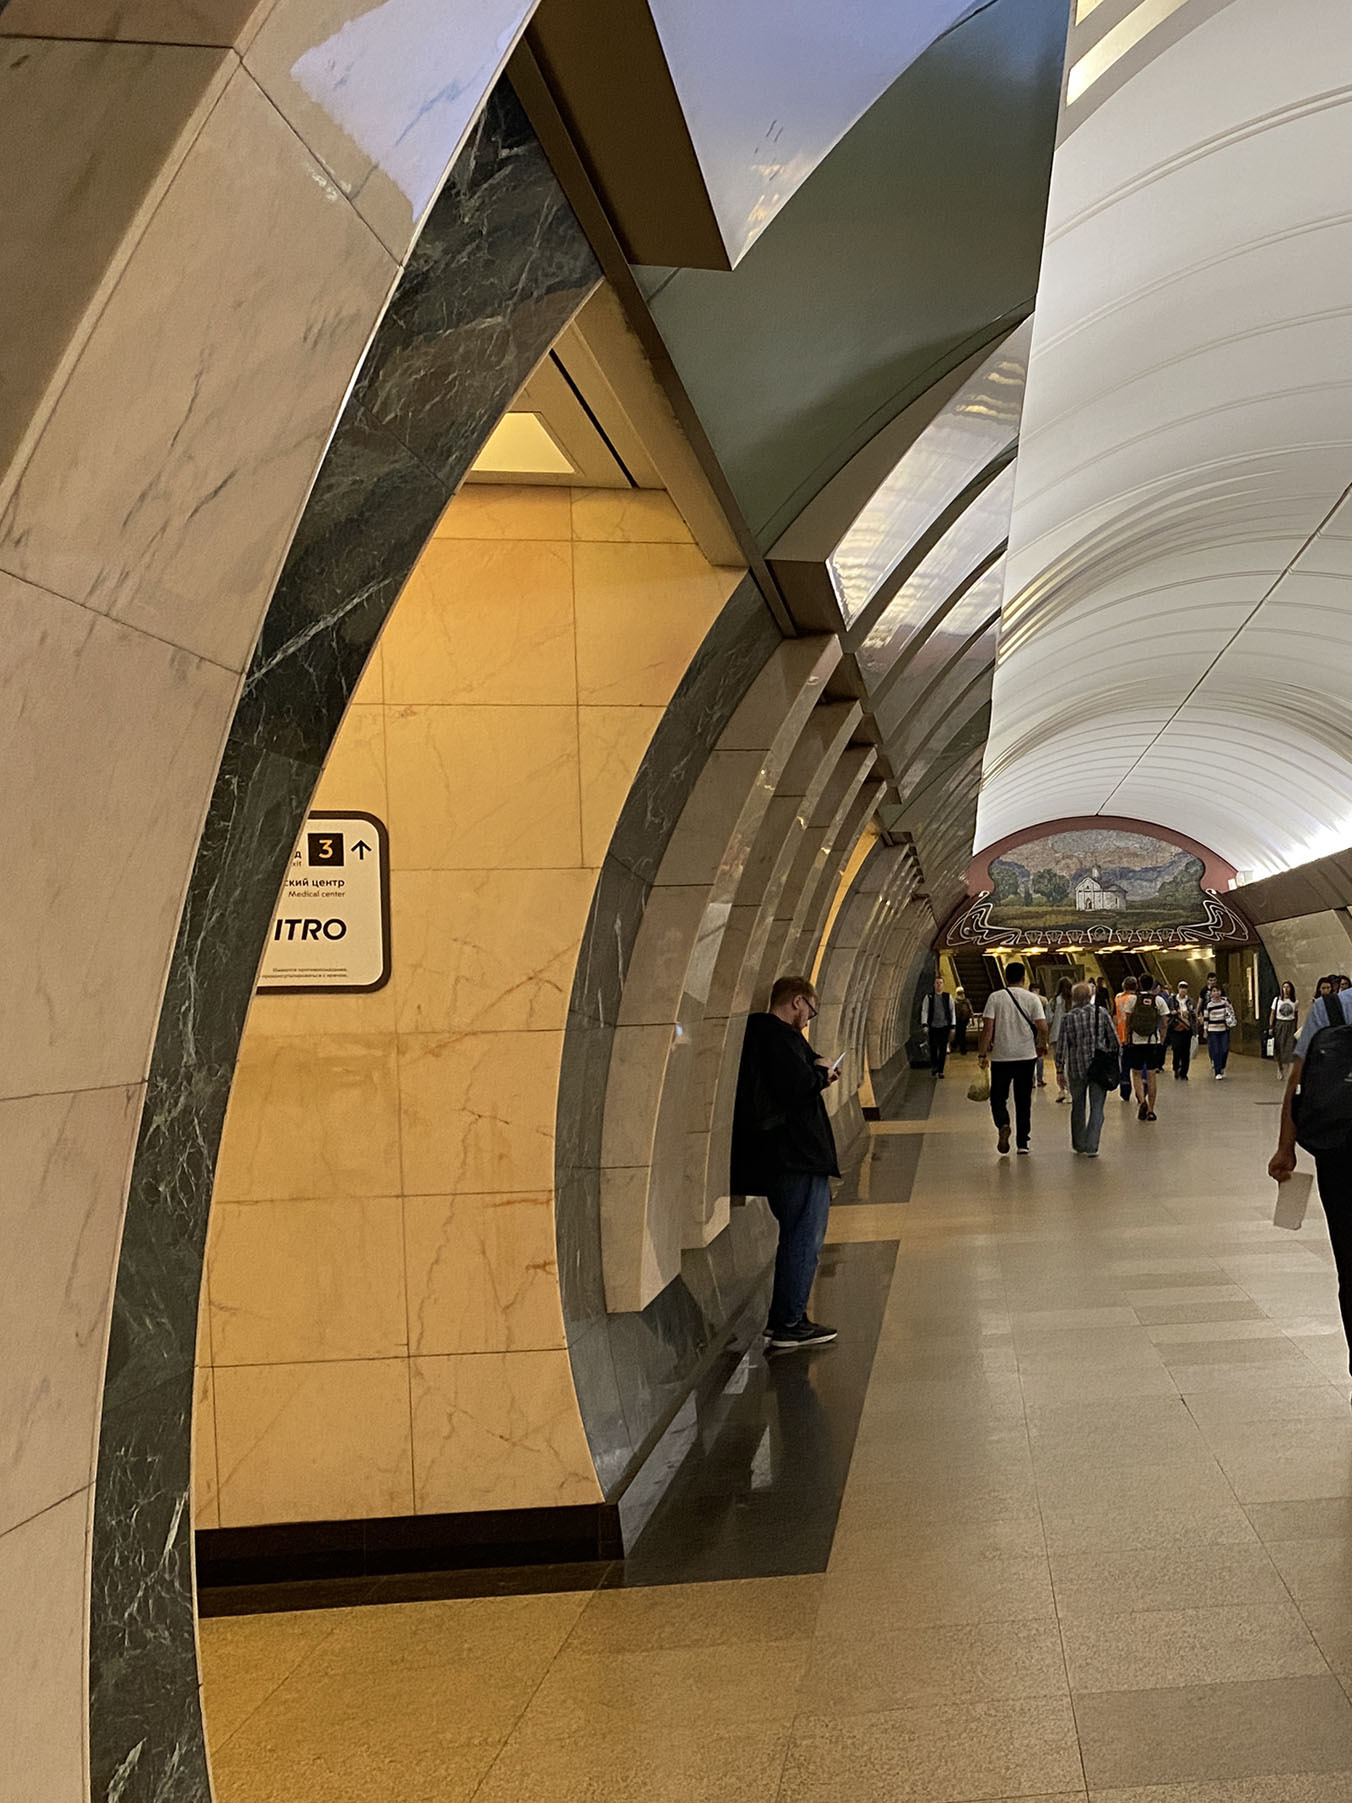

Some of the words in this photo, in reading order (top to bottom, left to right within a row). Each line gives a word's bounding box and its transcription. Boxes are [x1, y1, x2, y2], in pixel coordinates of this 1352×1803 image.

[318, 839, 334, 859] 3
[312, 879, 345, 889] центр
[288, 890, 320, 898] Medical
[274, 918, 347, 941] ITRO
